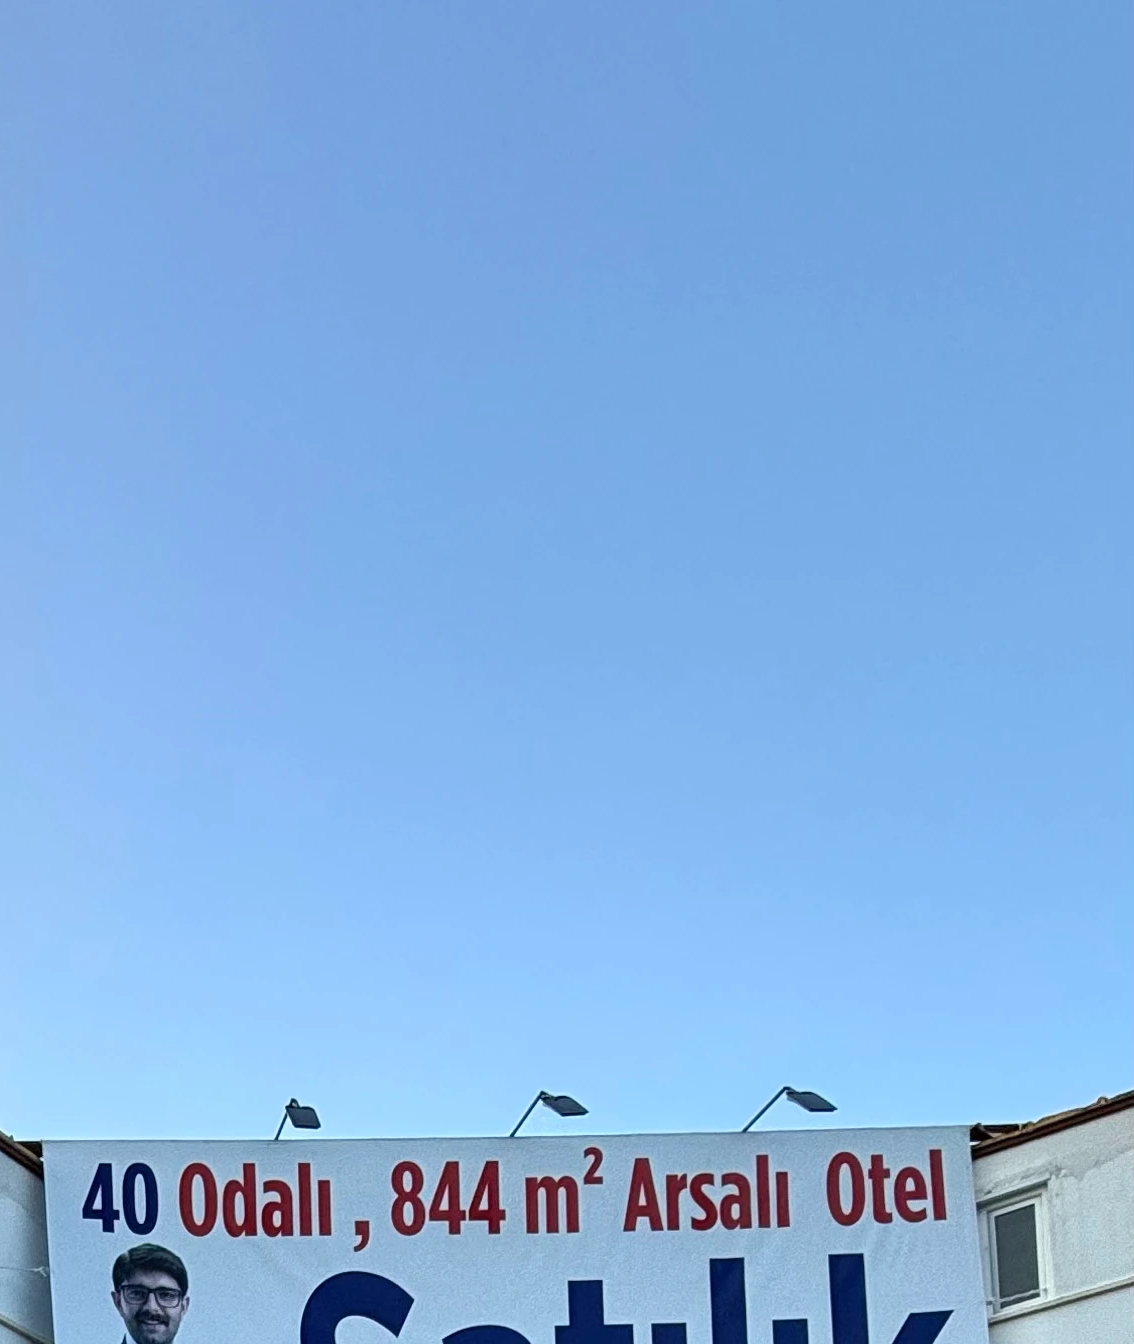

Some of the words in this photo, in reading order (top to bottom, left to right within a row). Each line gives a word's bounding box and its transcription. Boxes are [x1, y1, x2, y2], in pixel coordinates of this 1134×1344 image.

[81, 1161, 160, 1236] 40
[178, 1161, 333, 1238] Odalı
[390, 1160, 507, 1236] 844
[622, 1153, 792, 1232] Arsalı
[825, 1148, 948, 1228] Otel
